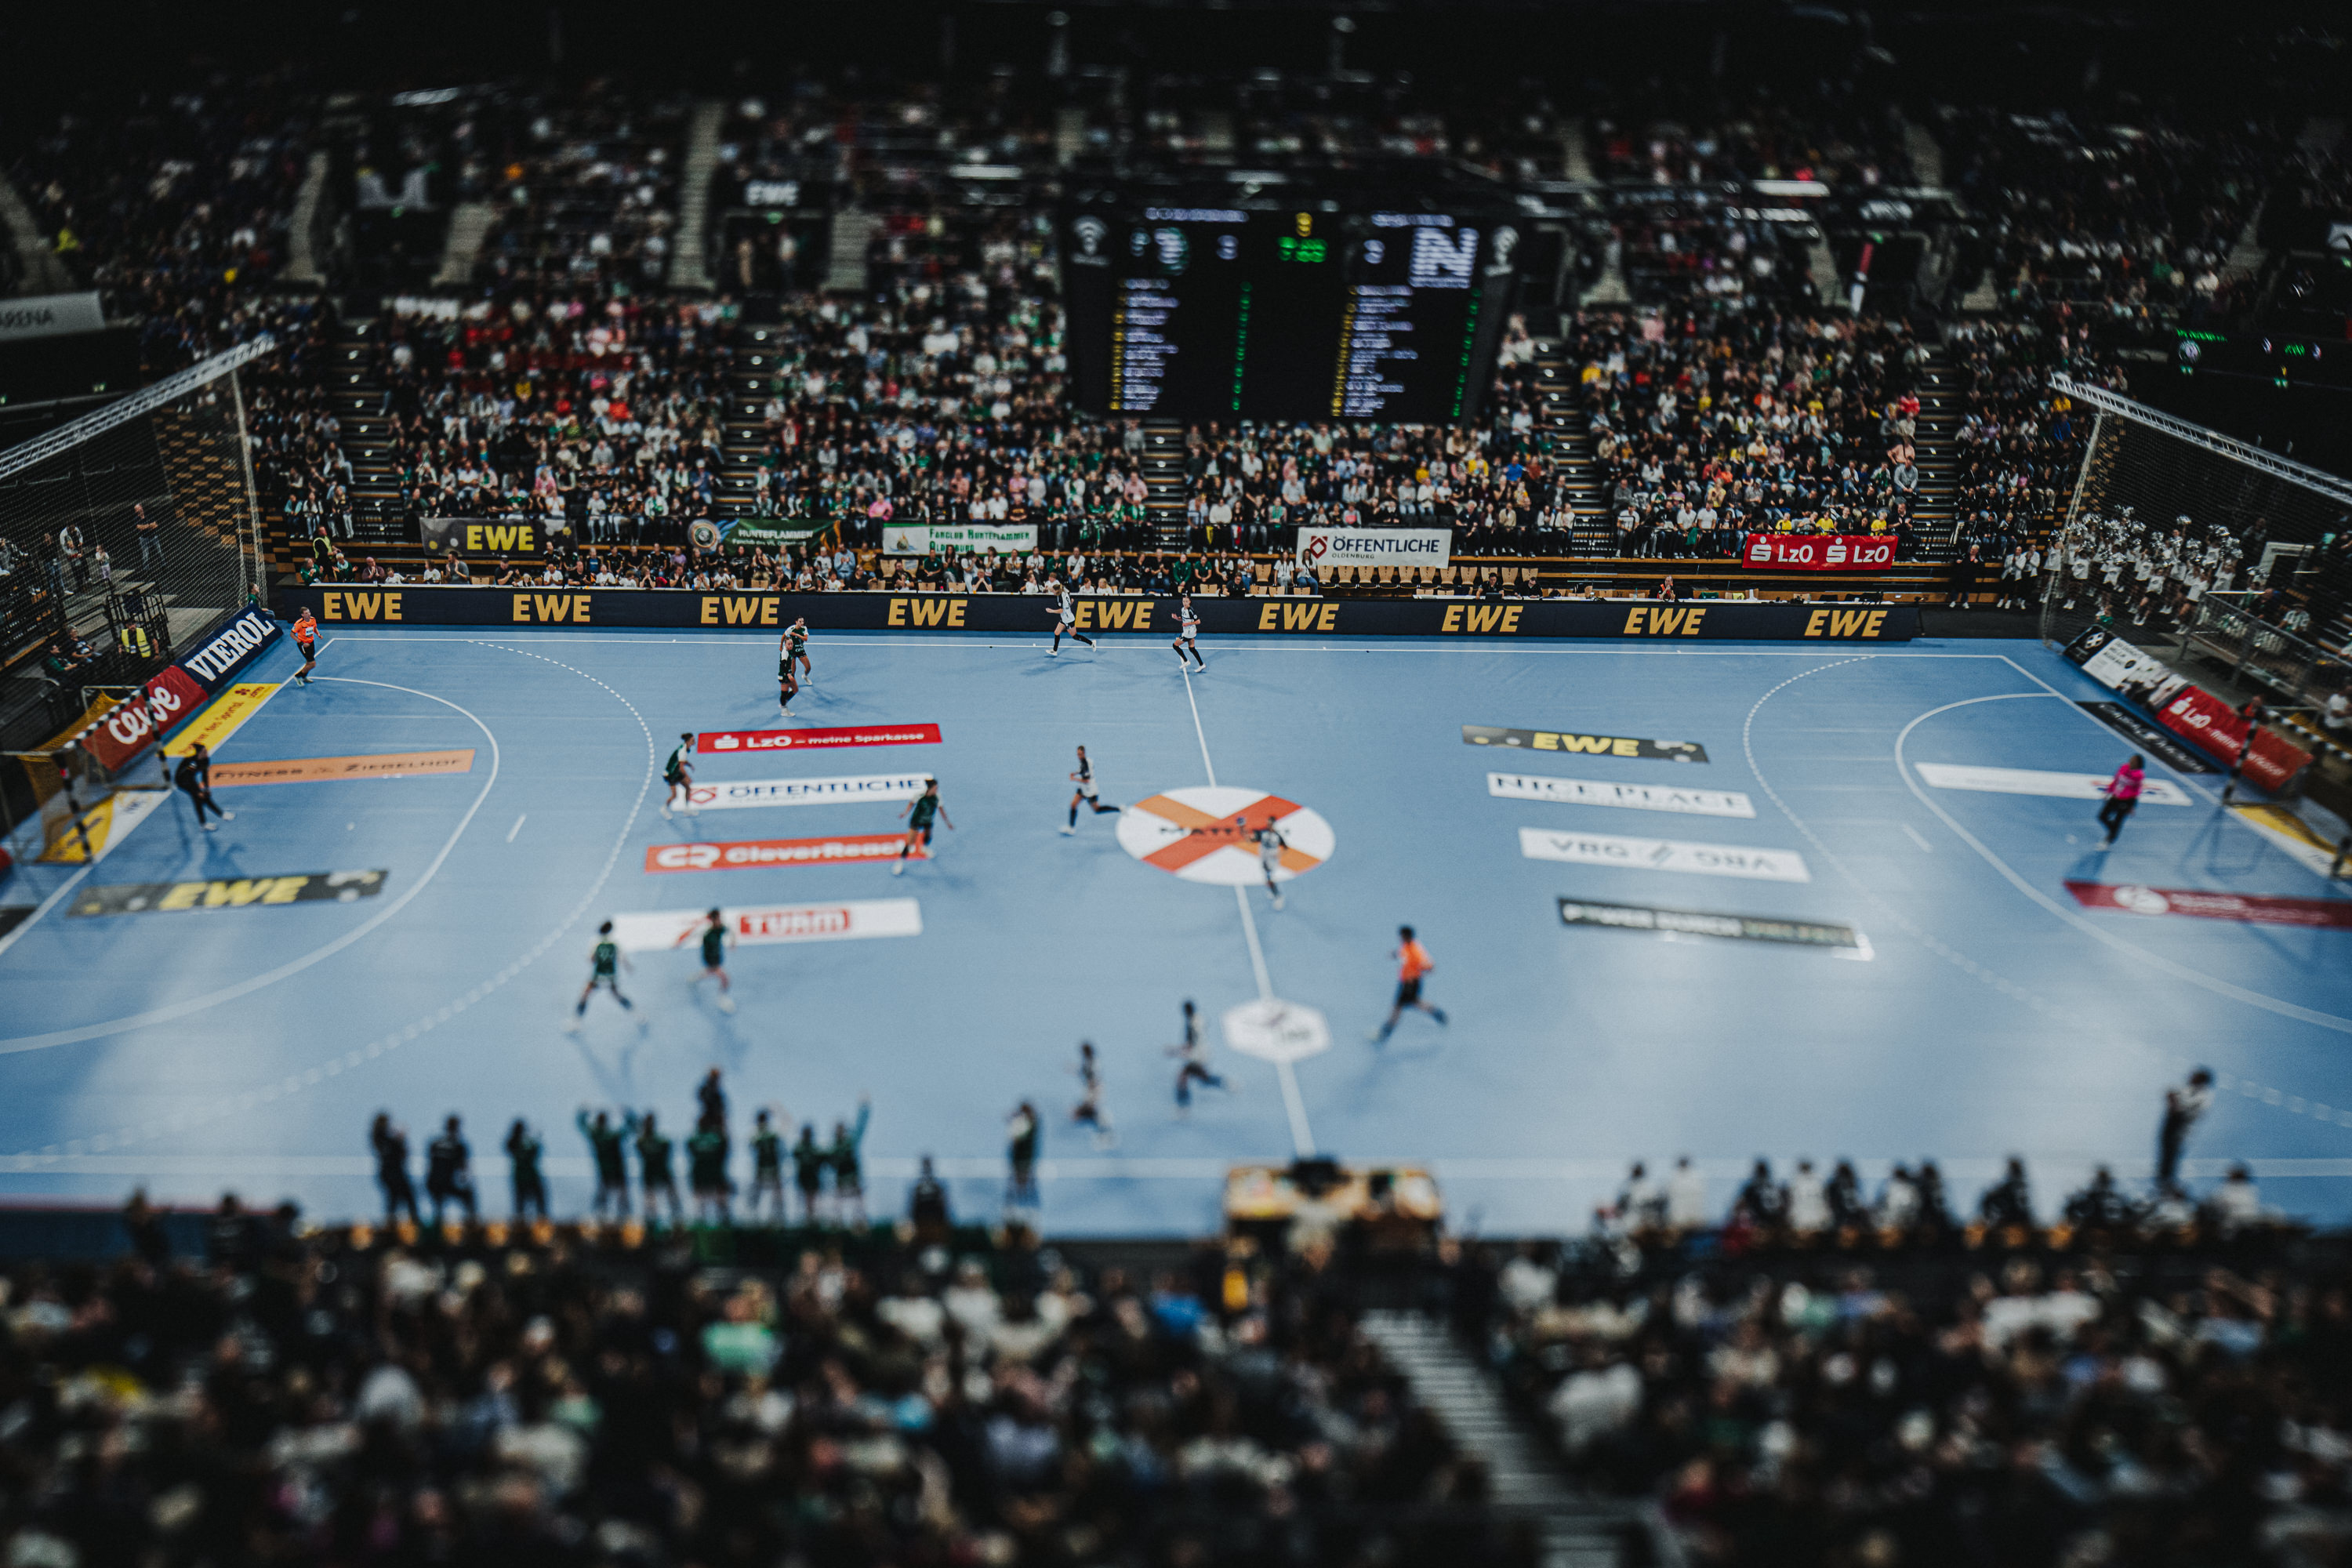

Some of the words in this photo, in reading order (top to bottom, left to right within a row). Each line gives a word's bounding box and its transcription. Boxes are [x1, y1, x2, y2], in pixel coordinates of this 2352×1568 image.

[466, 524, 535, 551] EWE
[739, 529, 814, 539] HUNTEFLAMMEN
[1333, 535, 1440, 553] ÖFFENTLICHE
[1777, 544, 1813, 564] LzO
[1853, 545, 1889, 564] LzO
[324, 593, 401, 619] EWE
[514, 594, 590, 622] EWE
[701, 597, 779, 624] EWE
[887, 598, 967, 626] EWE
[1075, 601, 1153, 629] EWE
[1259, 603, 1339, 630] EWE
[1442, 605, 1523, 632] EWE
[1624, 608, 1706, 634] EWE
[1804, 610, 1887, 637] EWE
[185, 612, 275, 674] VIEROL
[747, 735, 792, 748] LzO
[808, 736, 851, 745] meine
[854, 732, 924, 743] Sparkasse
[1532, 732, 1639, 757] EWE
[729, 779, 922, 798] ÖFFENTLICHE
[159, 876, 309, 912] EWE
